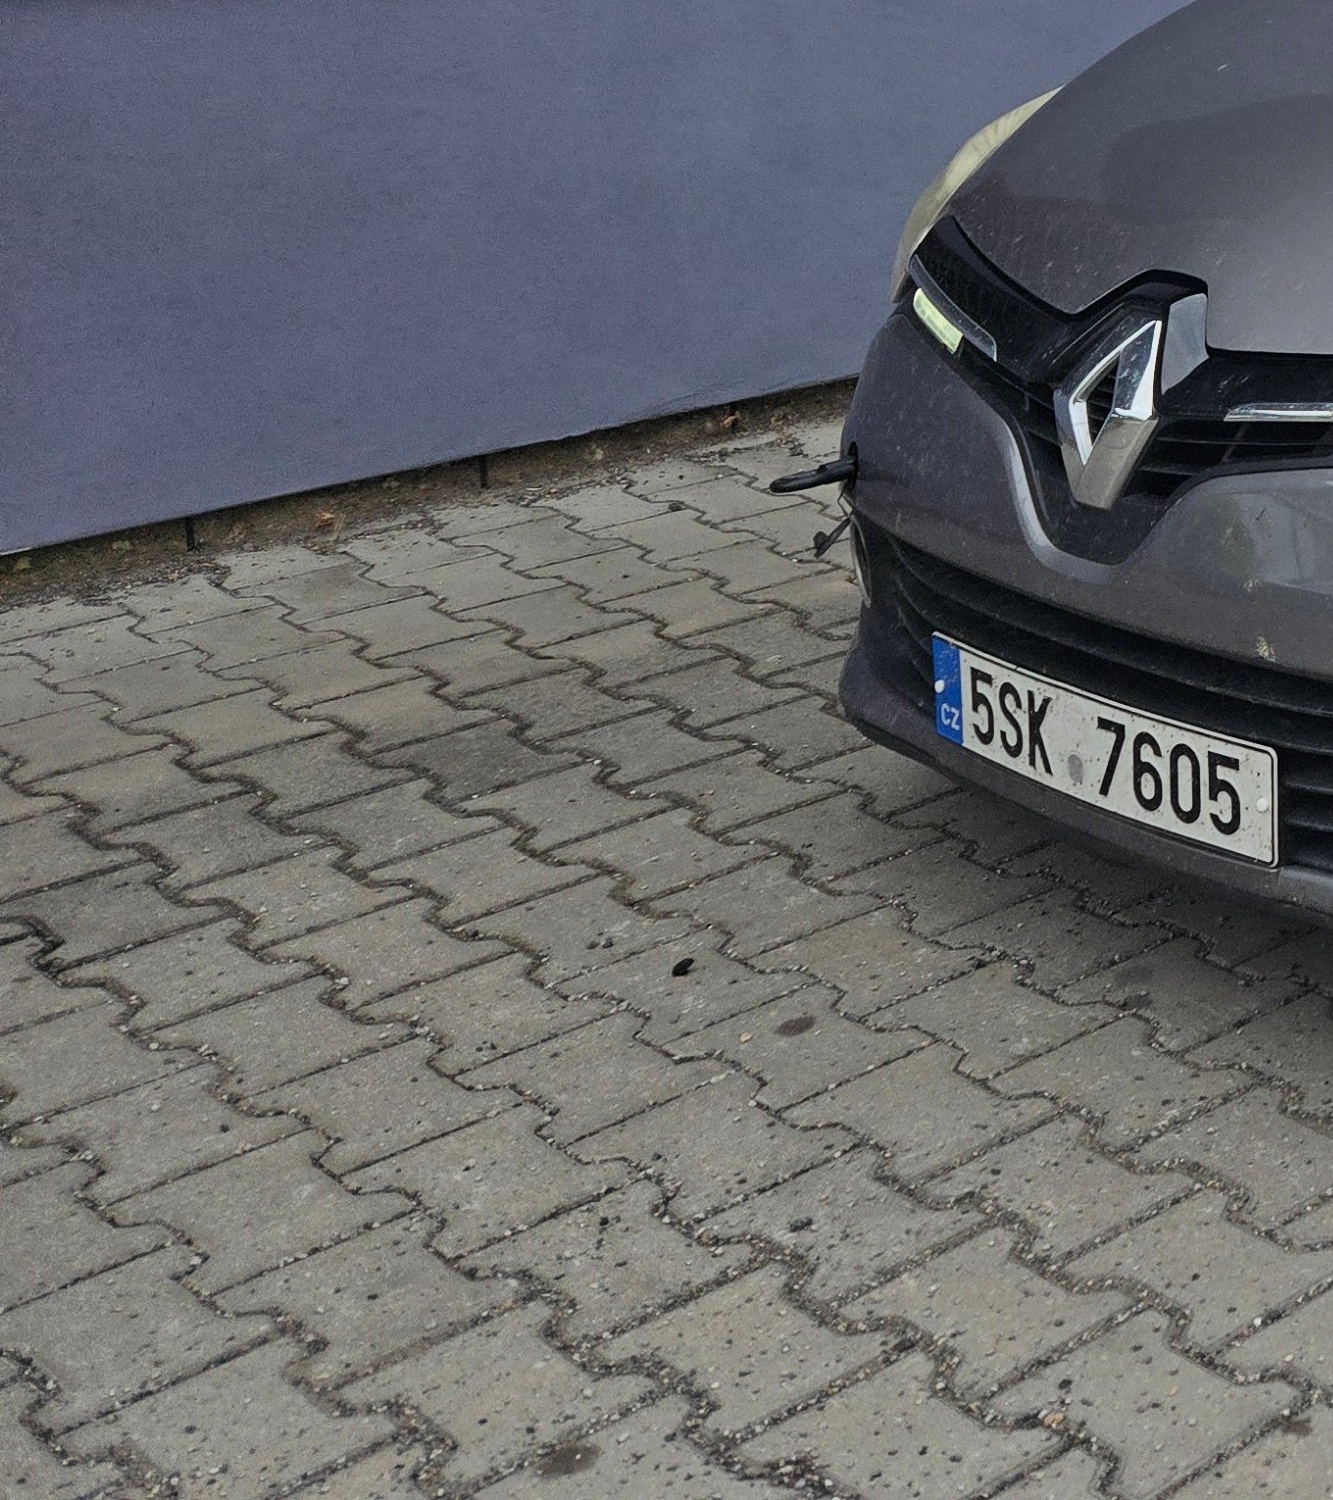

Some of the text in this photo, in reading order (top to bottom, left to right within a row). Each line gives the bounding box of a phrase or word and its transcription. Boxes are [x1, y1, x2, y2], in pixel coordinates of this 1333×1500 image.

[940, 702, 961, 731] CZ
[969, 666, 1241, 836] 5SK 7605
